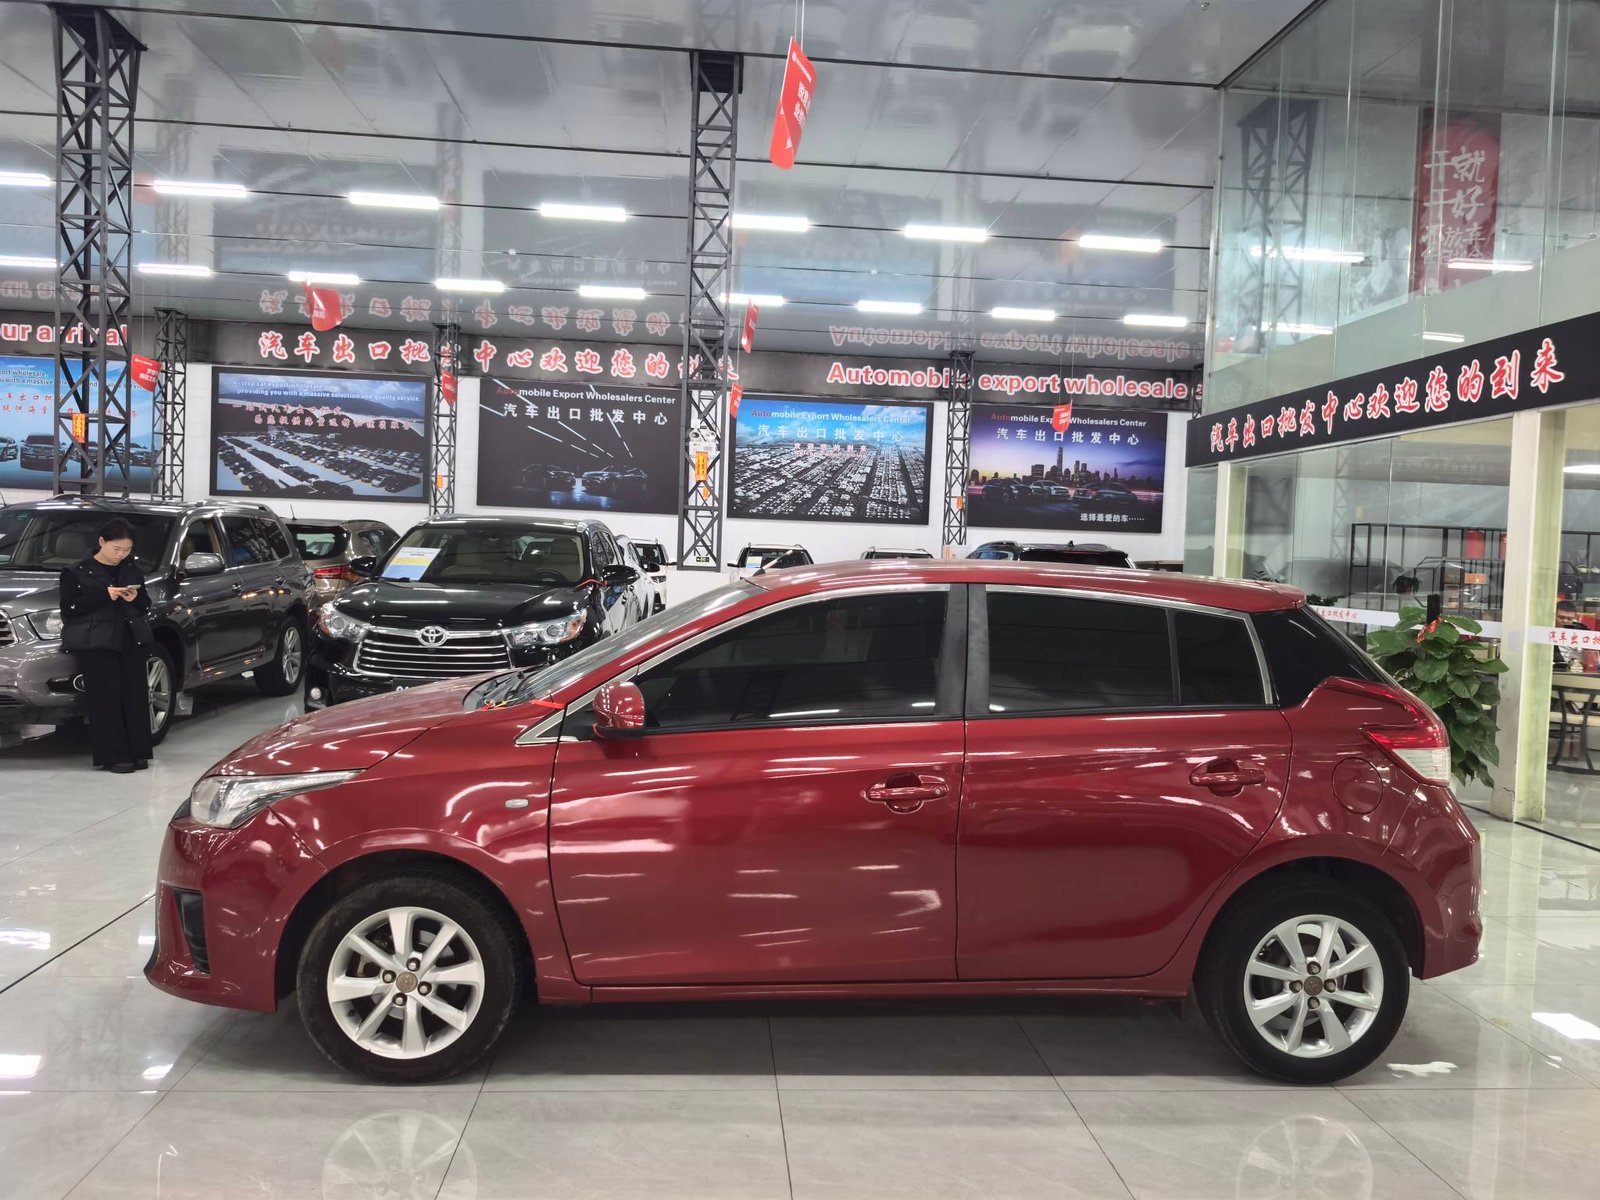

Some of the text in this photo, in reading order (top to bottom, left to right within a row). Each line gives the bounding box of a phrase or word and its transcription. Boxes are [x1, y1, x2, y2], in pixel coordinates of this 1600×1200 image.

[0, 322, 32, 342] ur
[978, 367, 1060, 395] export
[1064, 369, 1188, 399] wholesale
[237, 388, 268, 396] providing
[374, 393, 396, 401] quality
[496, 387, 676, 404] Automobile Export Wholesalers Center
[1210, 337, 1565, 453] 汽车出口批发中心欢迎您的到来
[503, 403, 668, 425] 汽车出口批发中心
[751, 408, 912, 424] Automobile Export Wholesalers Center
[991, 413, 1038, 423] Automobile
[1070, 417, 1119, 426] Wholesalers
[1119, 418, 1147, 427] Center
[758, 424, 904, 442] 汽车出口批发中心
[996, 428, 1140, 445] 汽车出口批发中心
